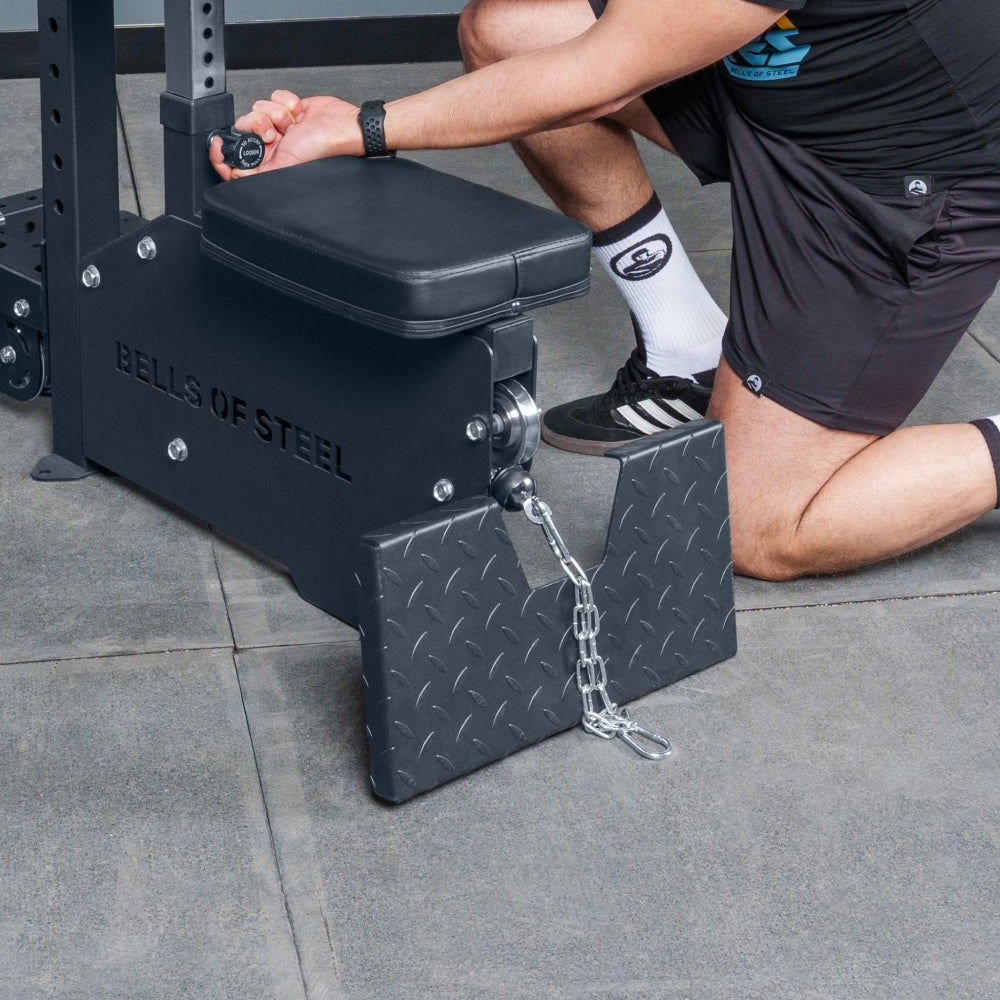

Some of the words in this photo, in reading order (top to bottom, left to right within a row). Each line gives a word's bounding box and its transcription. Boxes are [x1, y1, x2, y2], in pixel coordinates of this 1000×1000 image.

[765, 69, 794, 77] STEEL
[115, 340, 202, 409] BELLS
[210, 387, 247, 428] OF
[254, 408, 352, 484] STEEL
